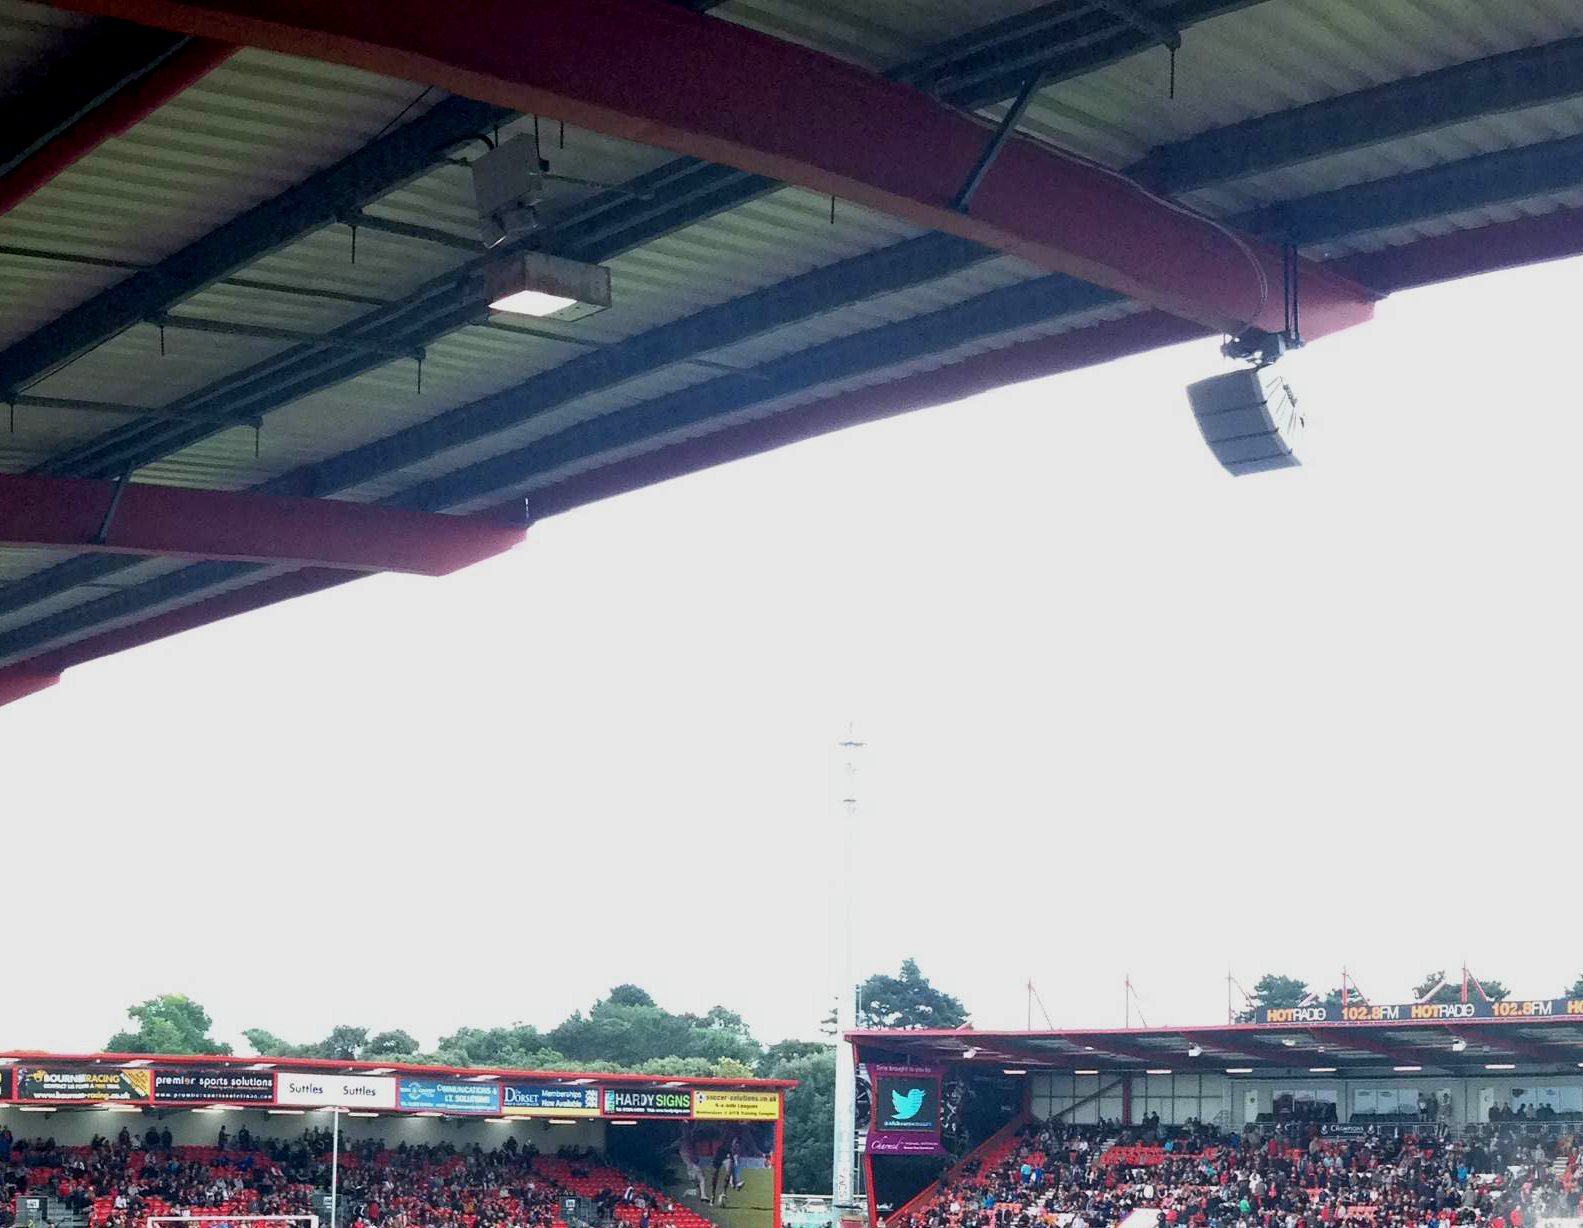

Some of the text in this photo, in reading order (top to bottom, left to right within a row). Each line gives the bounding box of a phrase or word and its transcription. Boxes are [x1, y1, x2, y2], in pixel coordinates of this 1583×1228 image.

[1267, 1007, 1326, 1022] HOTRADIO
[1342, 1005, 1399, 1020] 102.8FM
[1491, 1002, 1552, 1016] 102.8FM
[156, 1076, 196, 1087] premier
[199, 1076, 228, 1088] sports
[231, 1076, 273, 1087] solutions
[289, 1083, 377, 1097] Suttles Suttles
[615, 1093, 691, 1107] HARDY SIGNS
